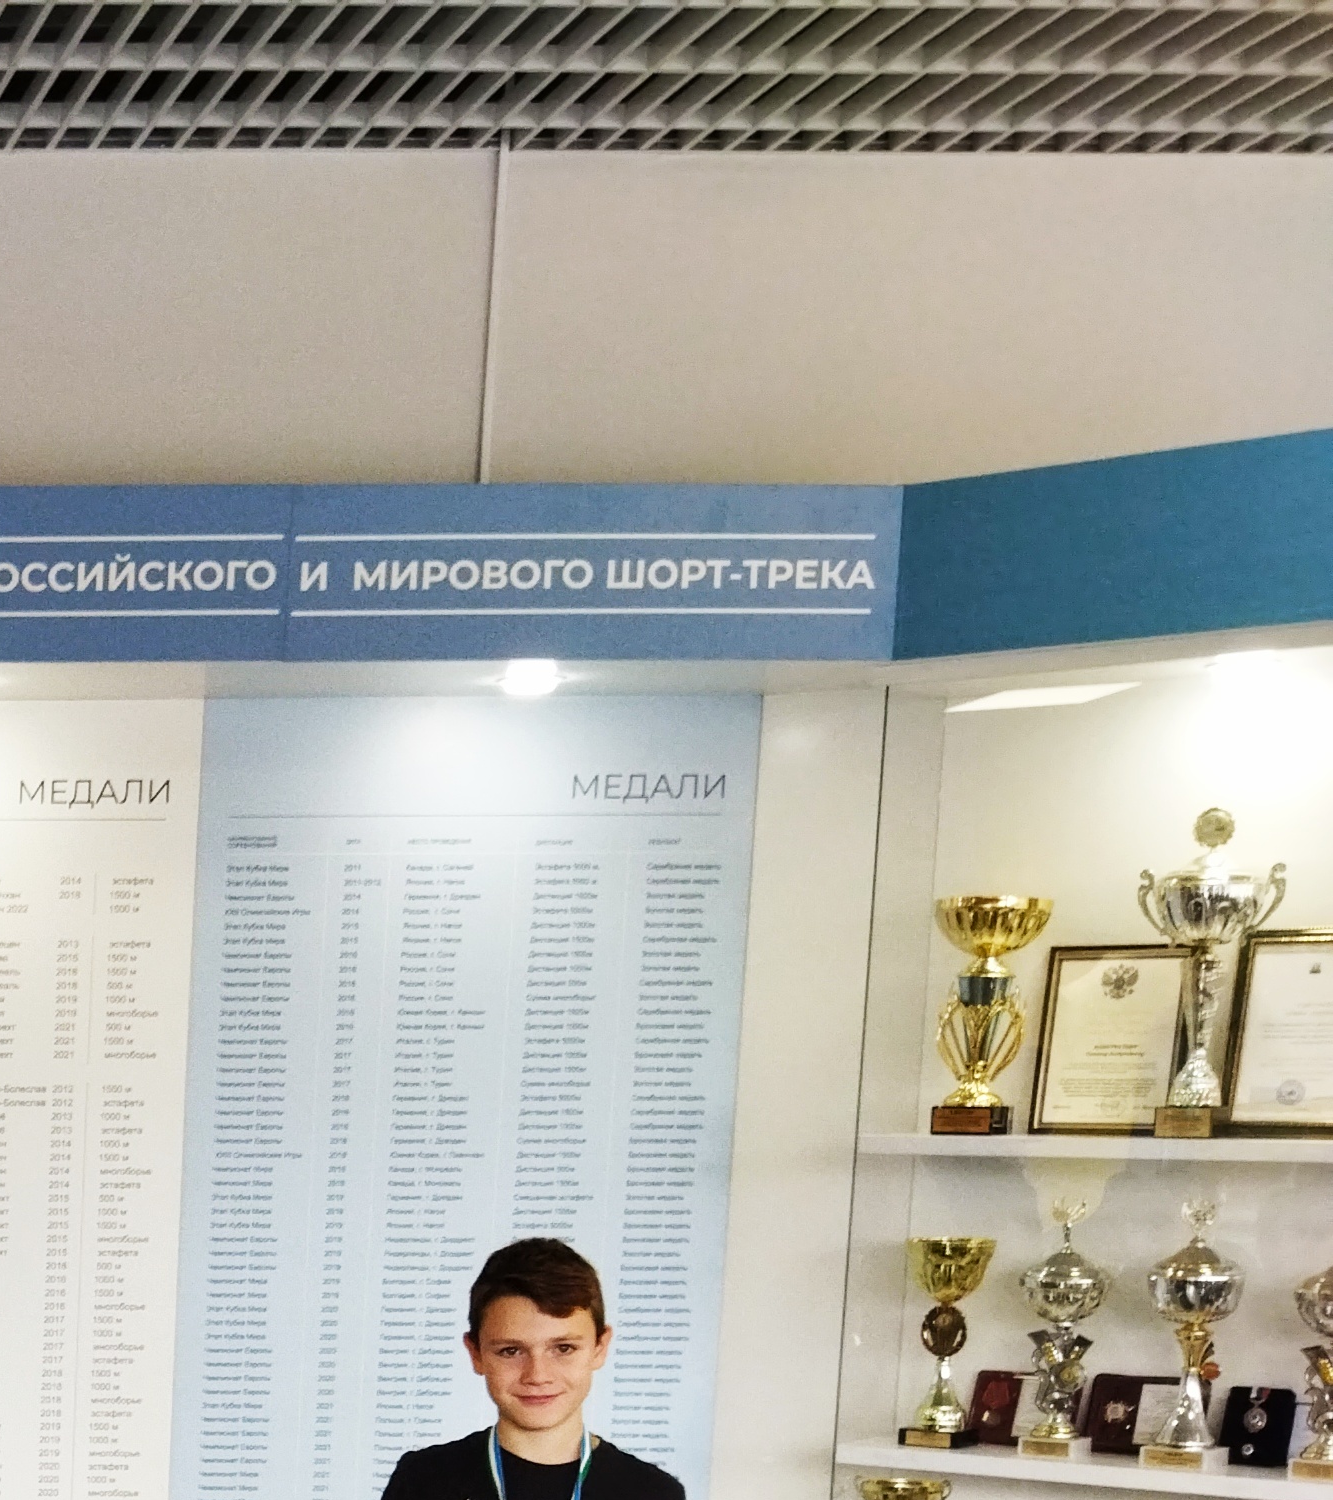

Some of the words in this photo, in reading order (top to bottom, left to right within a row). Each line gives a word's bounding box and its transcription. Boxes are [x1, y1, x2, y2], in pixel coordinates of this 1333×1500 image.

[301, 562, 328, 592] И
[353, 559, 594, 592] МИРОВОГО
[605, 558, 876, 591] ШОРТ-ТРЕКА
[19, 779, 170, 809] МЕДАЛИ
[572, 774, 727, 804] МЕДАЛИ
